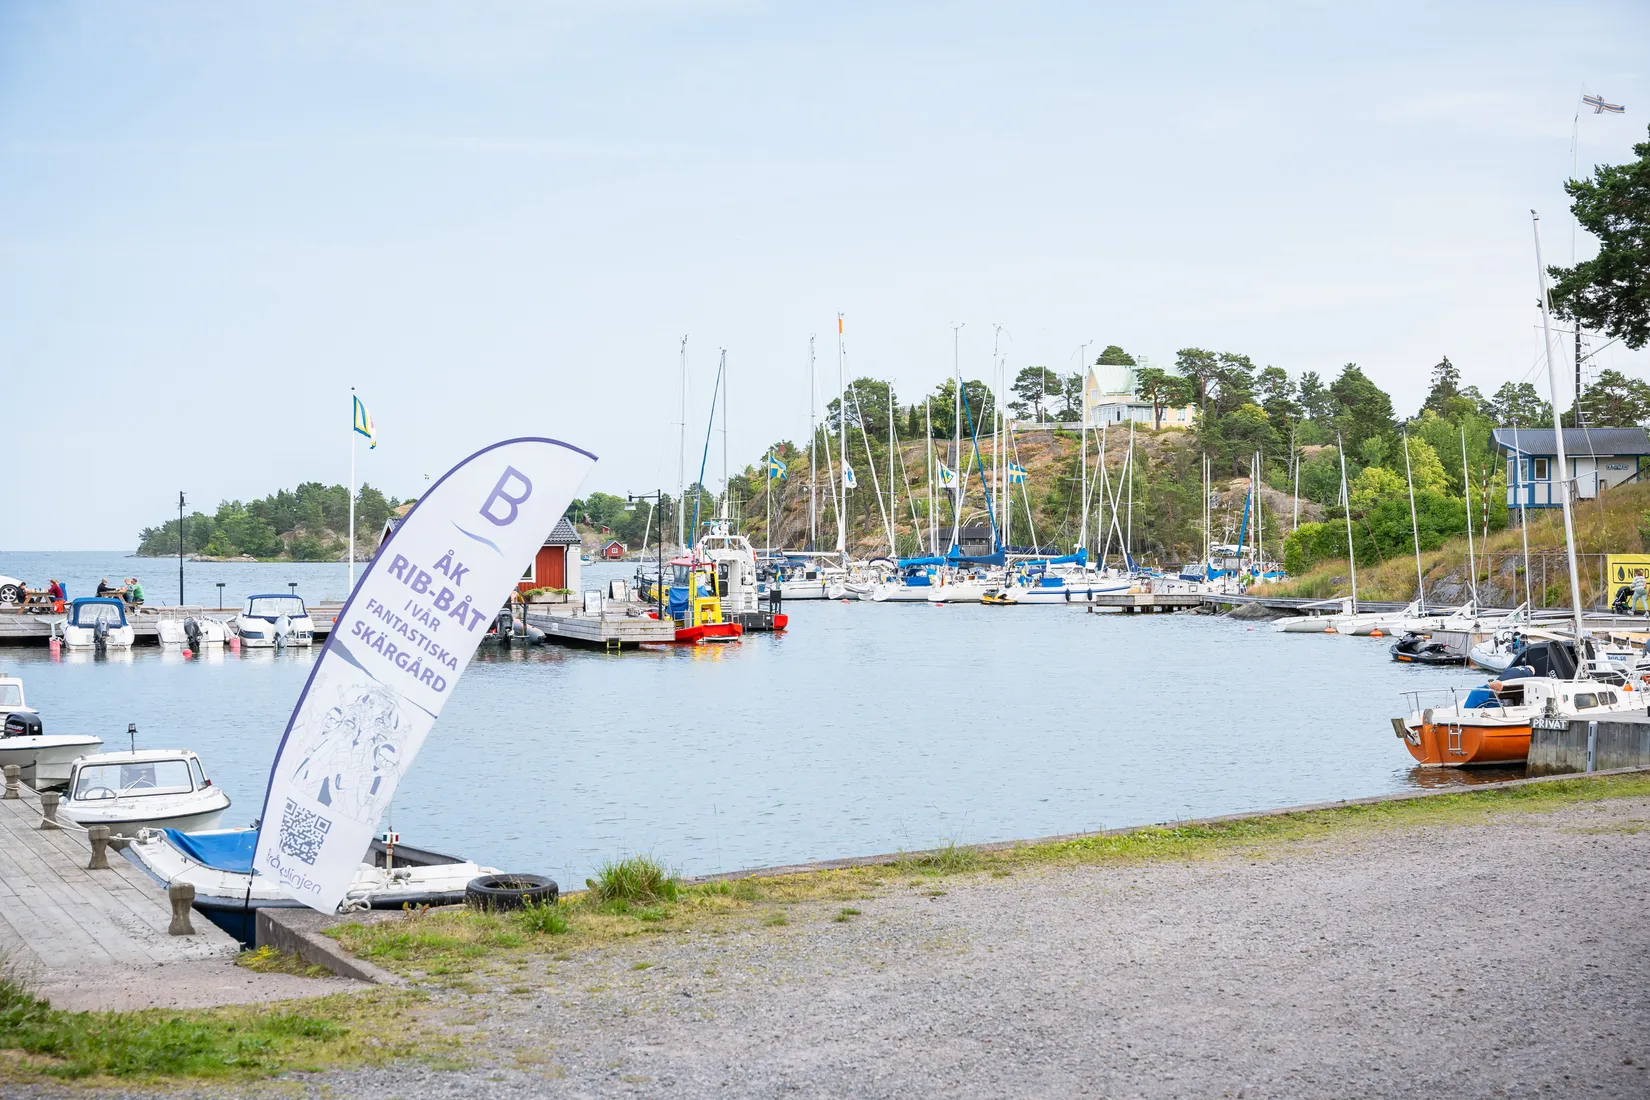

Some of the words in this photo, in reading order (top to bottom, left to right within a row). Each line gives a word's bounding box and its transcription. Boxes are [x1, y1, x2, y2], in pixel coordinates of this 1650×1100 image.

[479, 465, 532, 526] B
[387, 553, 487, 632] RIB-BÅT
[433, 549, 470, 587] ÅK
[365, 598, 458, 671] FANTASTISKA
[404, 599, 413, 611] I
[411, 603, 441, 632] VÅR
[351, 620, 447, 692] SKÄRGÅRD
[1532, 718, 1567, 730] PRIVAT
